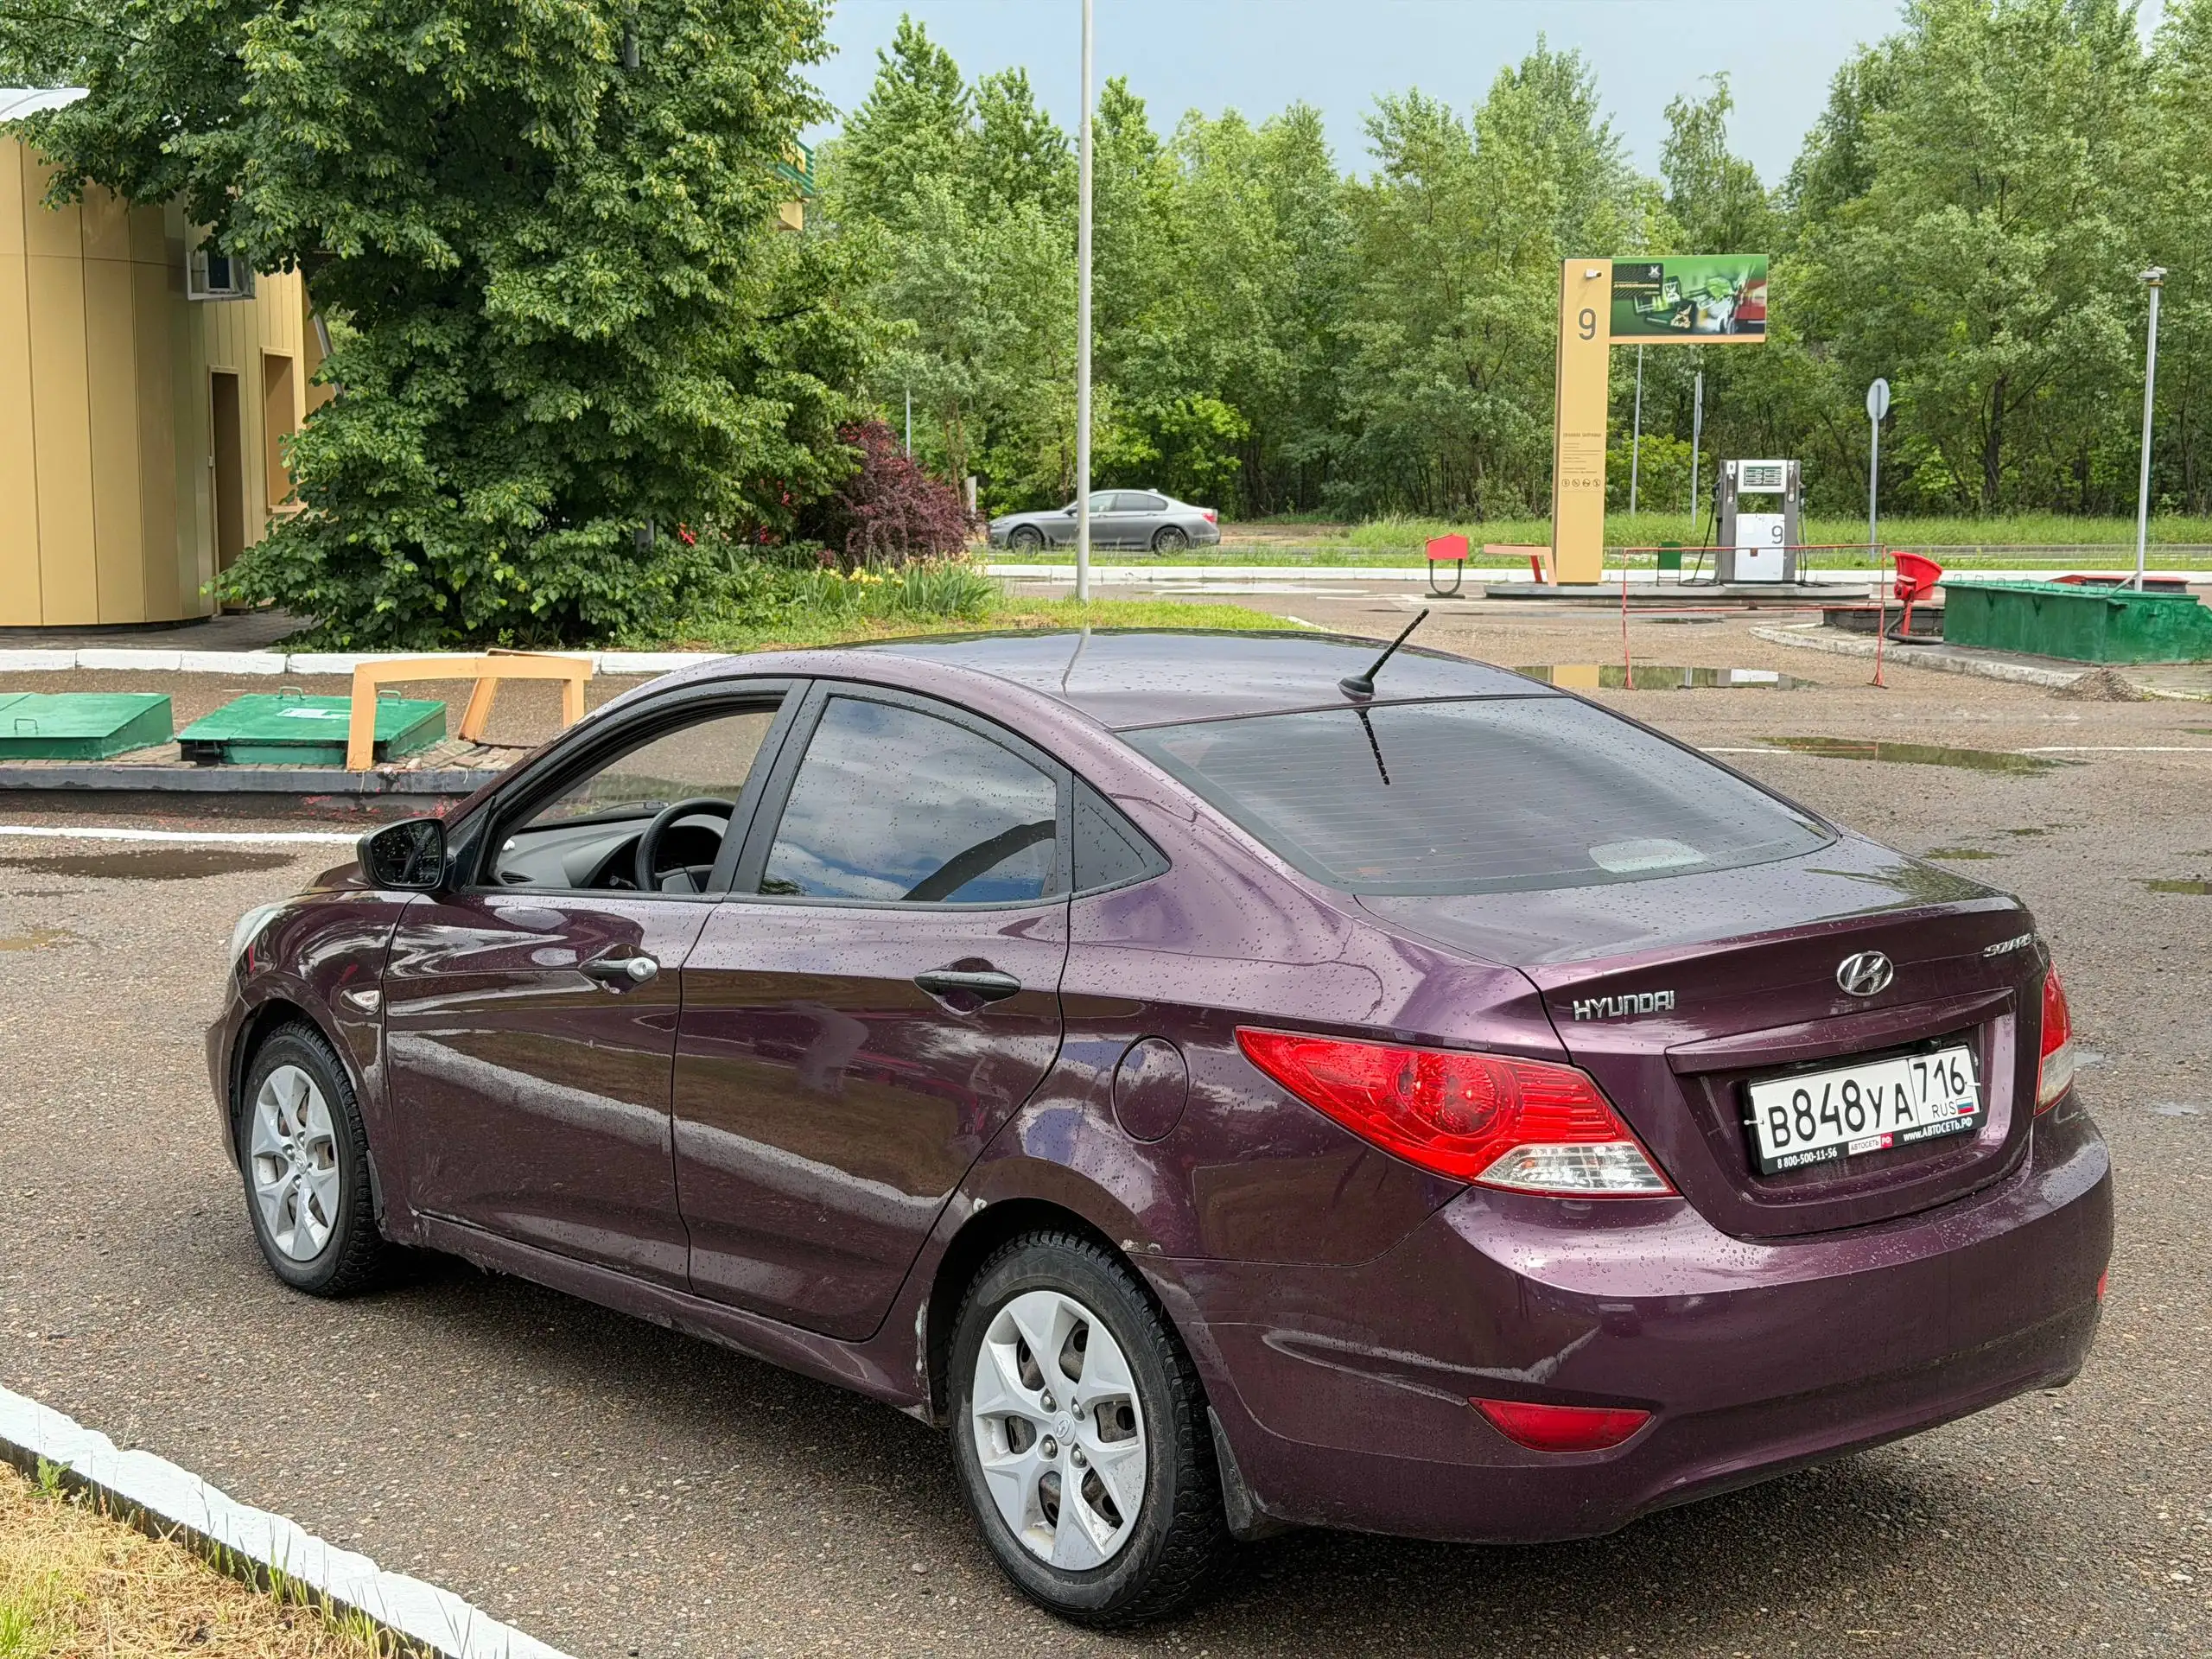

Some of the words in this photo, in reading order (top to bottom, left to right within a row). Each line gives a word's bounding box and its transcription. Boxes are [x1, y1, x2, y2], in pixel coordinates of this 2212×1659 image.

[1579, 308, 1596, 340] 9
[1771, 525, 1783, 544] 9
[1983, 933, 2032, 957] SOLARIS
[1573, 990, 1675, 1020] HYUNDAI
[1912, 1056, 1966, 1103] 716
[1931, 1101, 1956, 1118] RUS
[1777, 1158, 1783, 1169] 8
[1783, 1147, 1838, 1167] 800-500-11-56
